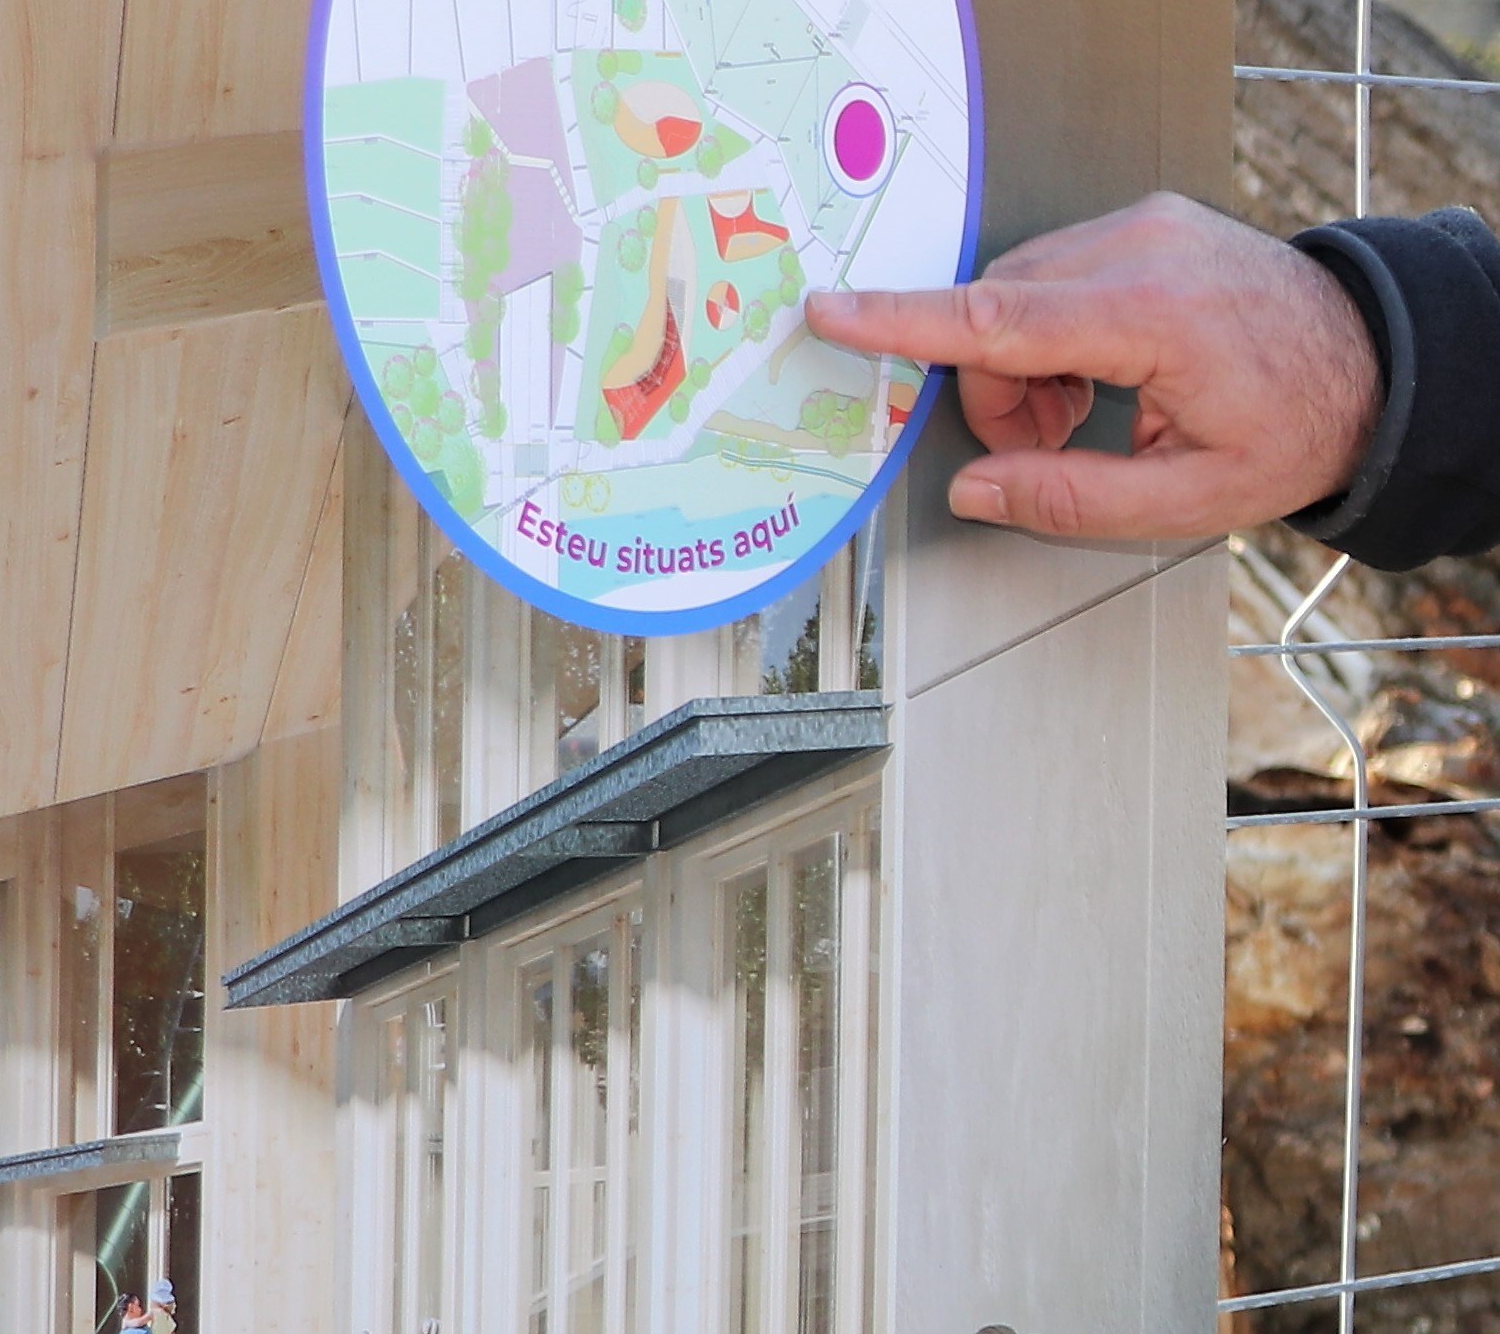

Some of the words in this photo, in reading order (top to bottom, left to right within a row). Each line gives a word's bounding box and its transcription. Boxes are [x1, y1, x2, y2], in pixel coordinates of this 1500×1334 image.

[516, 500, 608, 568] Esteu
[615, 535, 725, 575] situats
[733, 491, 800, 558] aquí
